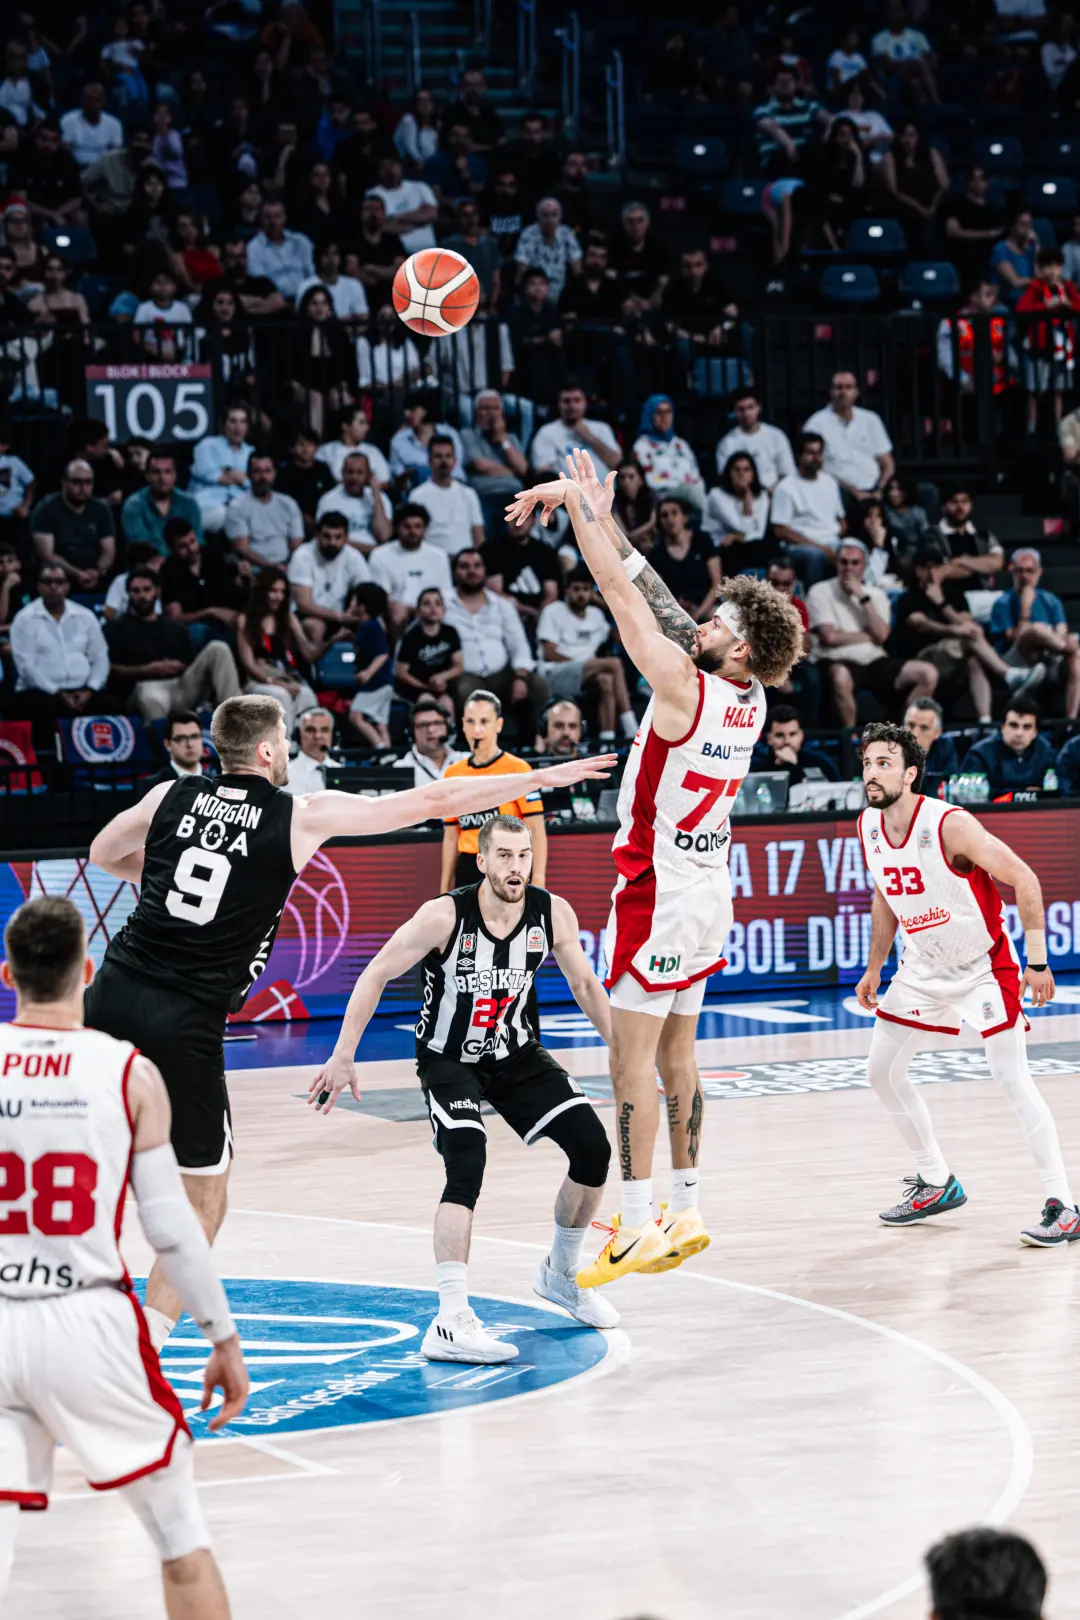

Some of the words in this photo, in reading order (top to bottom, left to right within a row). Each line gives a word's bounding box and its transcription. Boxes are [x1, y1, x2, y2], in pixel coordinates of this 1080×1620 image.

[148, 365, 189, 378] BLOCK
[94, 383, 209, 441] 105
[722, 706, 757, 728] HALE
[701, 742, 731, 760] BAU
[190, 792, 263, 829] MORGAN
[764, 840, 805, 897] 17
[883, 866, 926, 896] 33
[165, 845, 232, 926] 9
[649, 954, 681, 973] HDI
[2, 1053, 72, 1077] PONI
